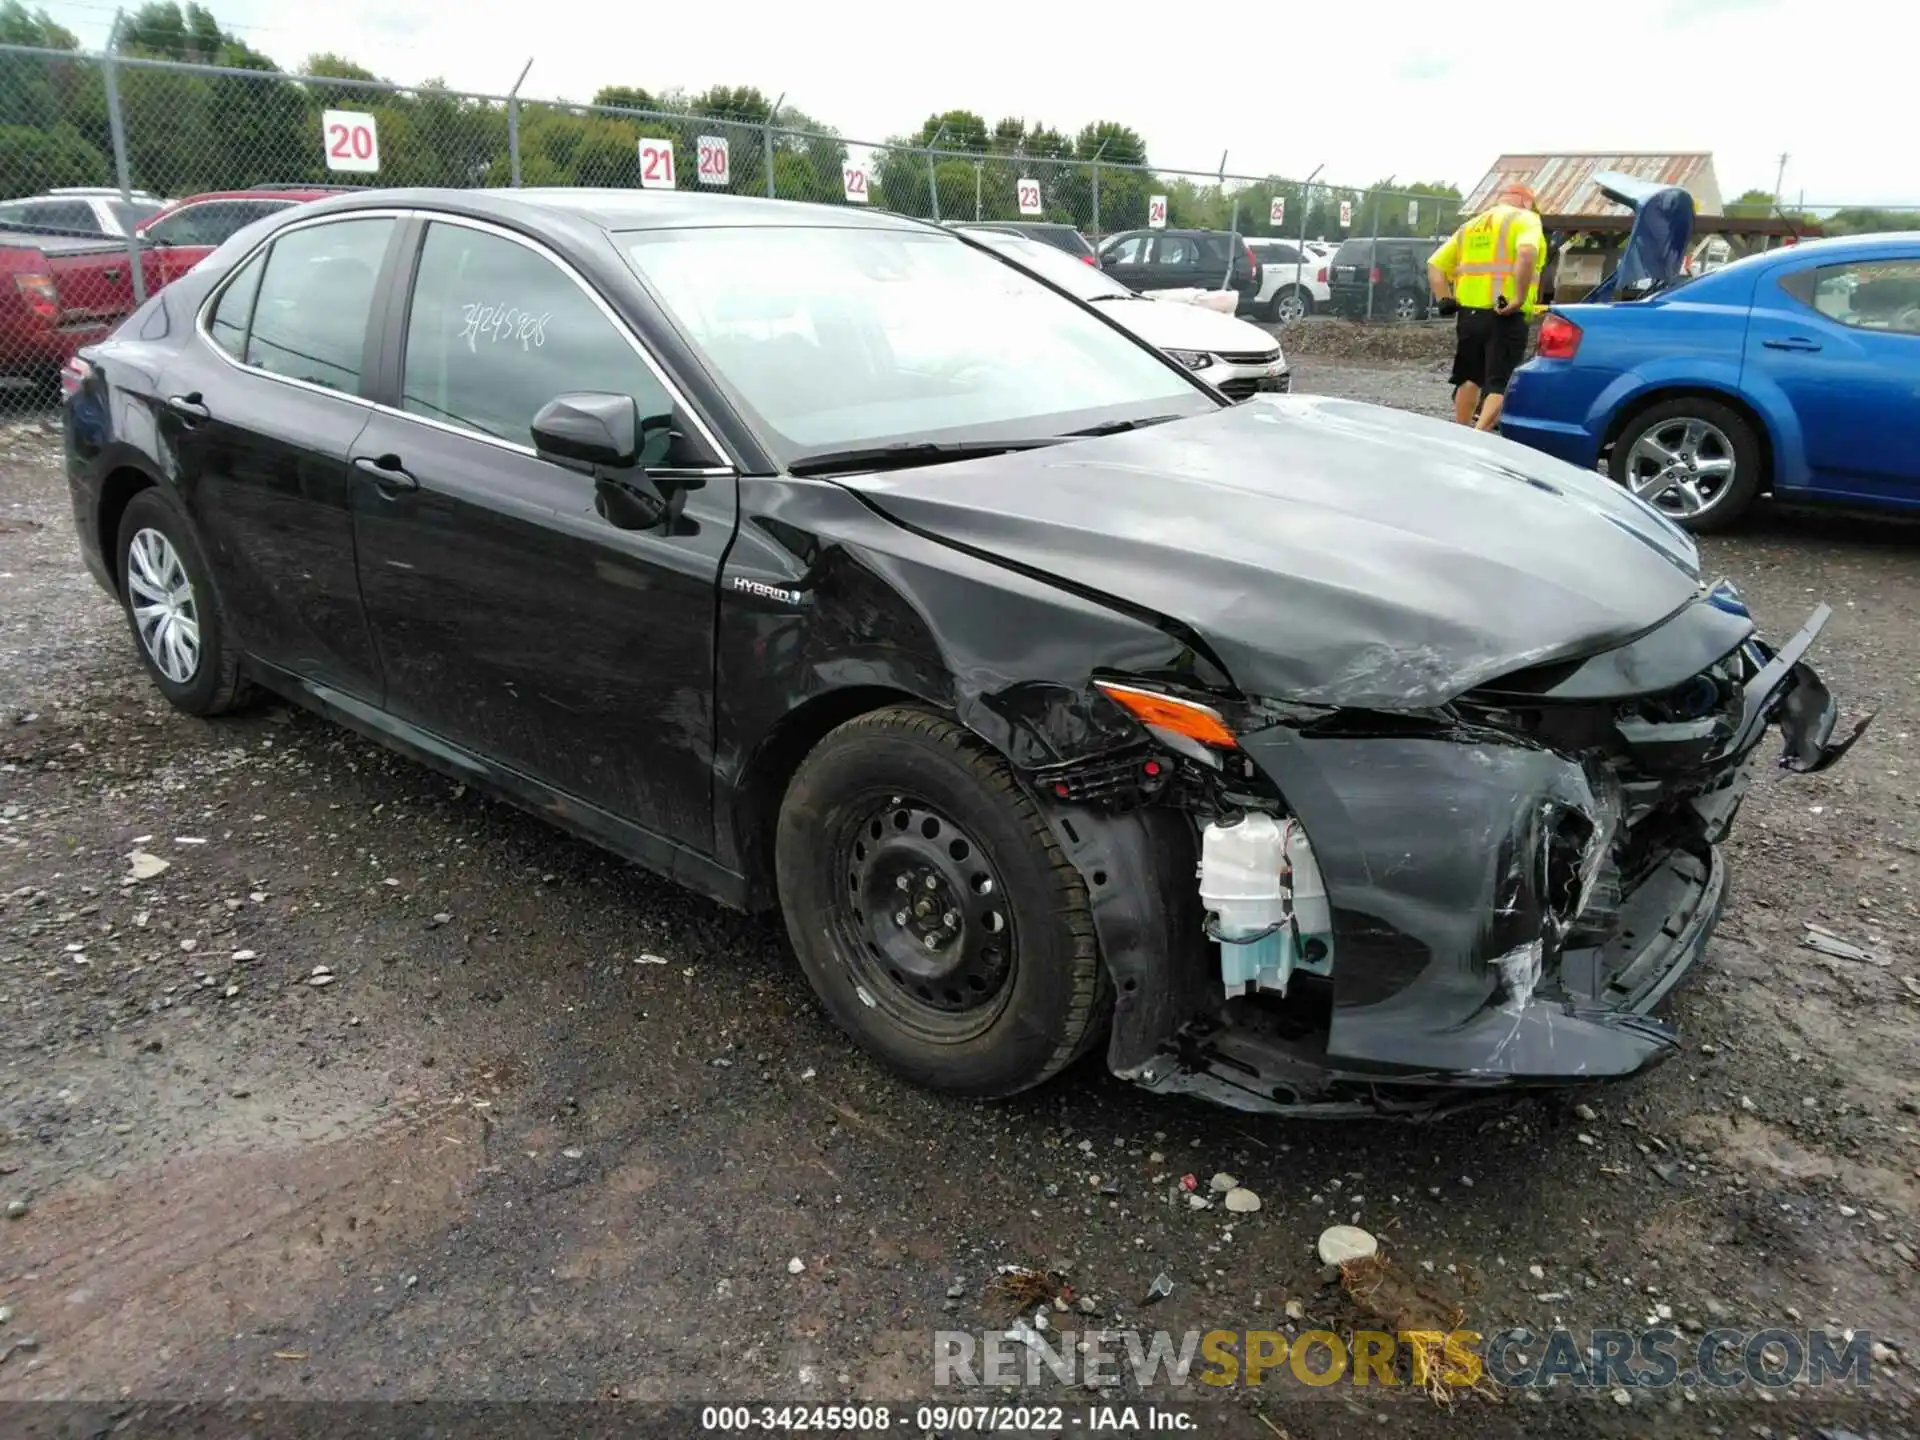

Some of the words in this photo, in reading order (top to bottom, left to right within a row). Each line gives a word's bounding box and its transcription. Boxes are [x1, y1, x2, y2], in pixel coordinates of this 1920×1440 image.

[330, 123, 373, 160] 20
[642, 147, 672, 181] 21
[700, 146, 726, 174] 20
[846, 169, 865, 193] 22
[1020, 187, 1038, 207] 23
[1150, 202, 1164, 221] 24
[733, 577, 790, 603] HYBRID
